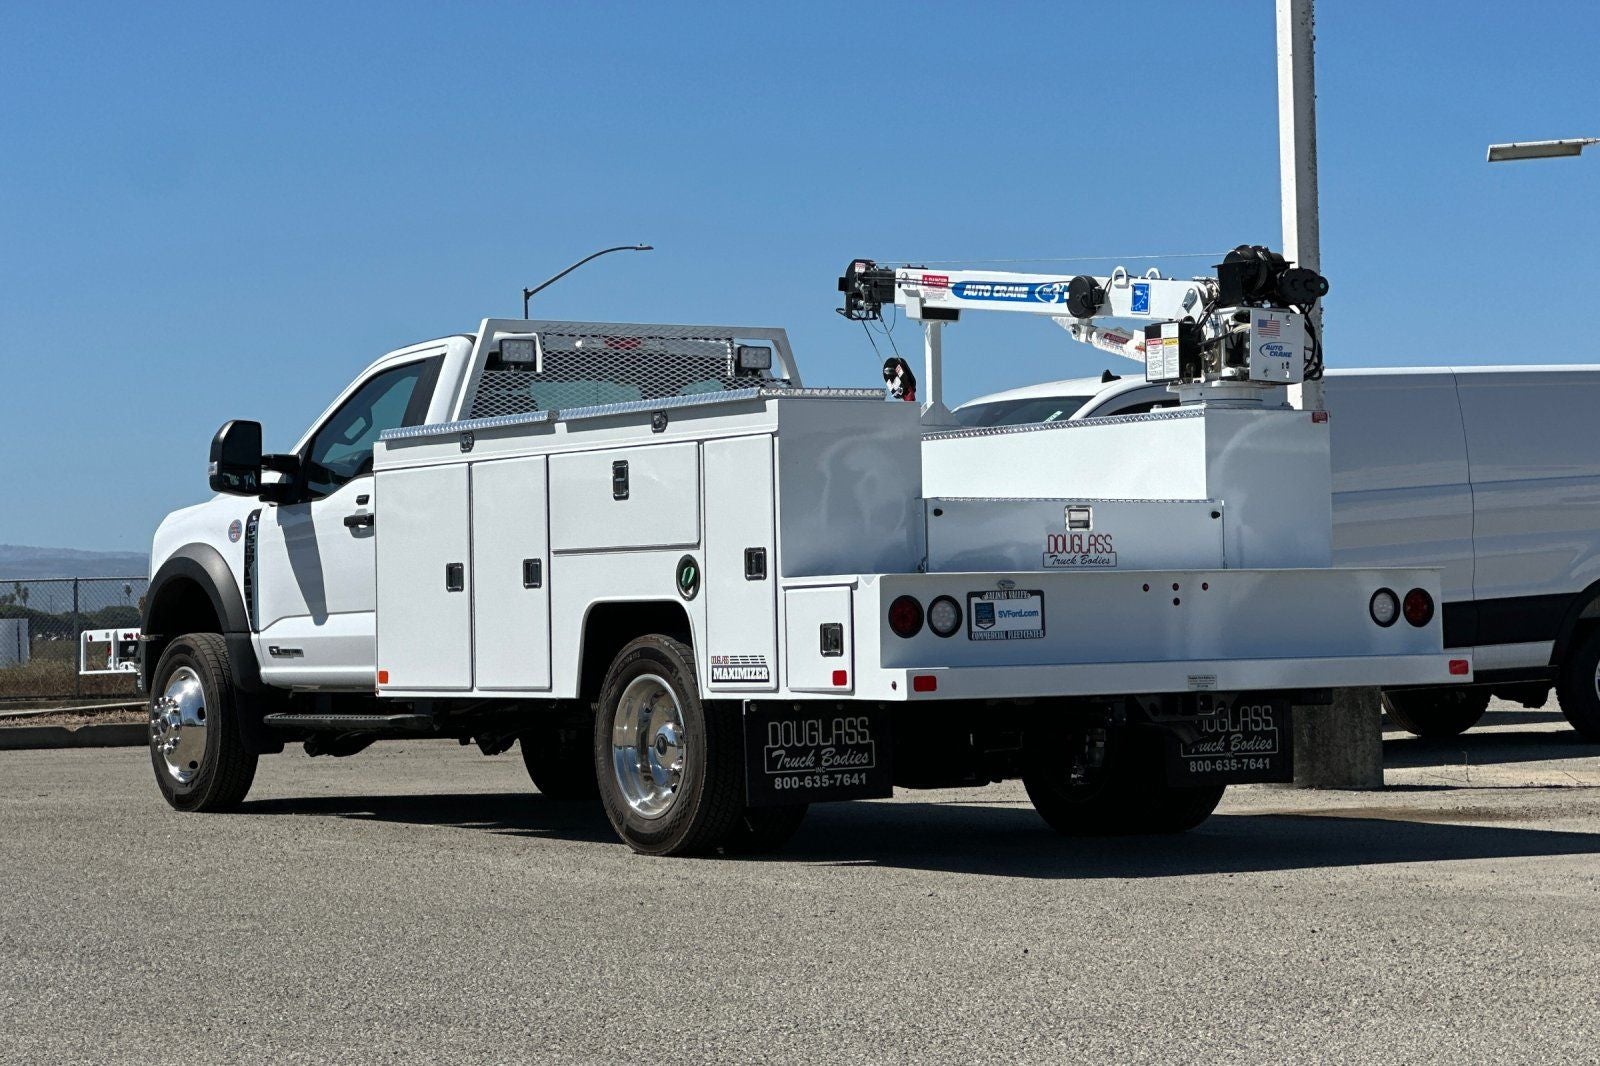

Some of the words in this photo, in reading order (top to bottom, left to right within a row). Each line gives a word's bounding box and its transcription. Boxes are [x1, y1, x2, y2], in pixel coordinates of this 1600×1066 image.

[963, 285, 991, 297] AUTO
[993, 285, 1029, 298] CRANE
[1047, 533, 1113, 554] DOUGLASS
[1049, 554, 1077, 565] Truck
[1080, 554, 1110, 565] Bodies
[998, 609, 1039, 618] SVFord.com
[713, 667, 768, 680] MAXIMIZER
[768, 716, 869, 748] DOUGLASS
[1230, 734, 1273, 751] Bodies
[772, 749, 815, 769] Truck
[820, 747, 869, 767] Bodies
[1189, 758, 1271, 773] 800-635-7641
[774, 772, 867, 790] 800-635-7641
